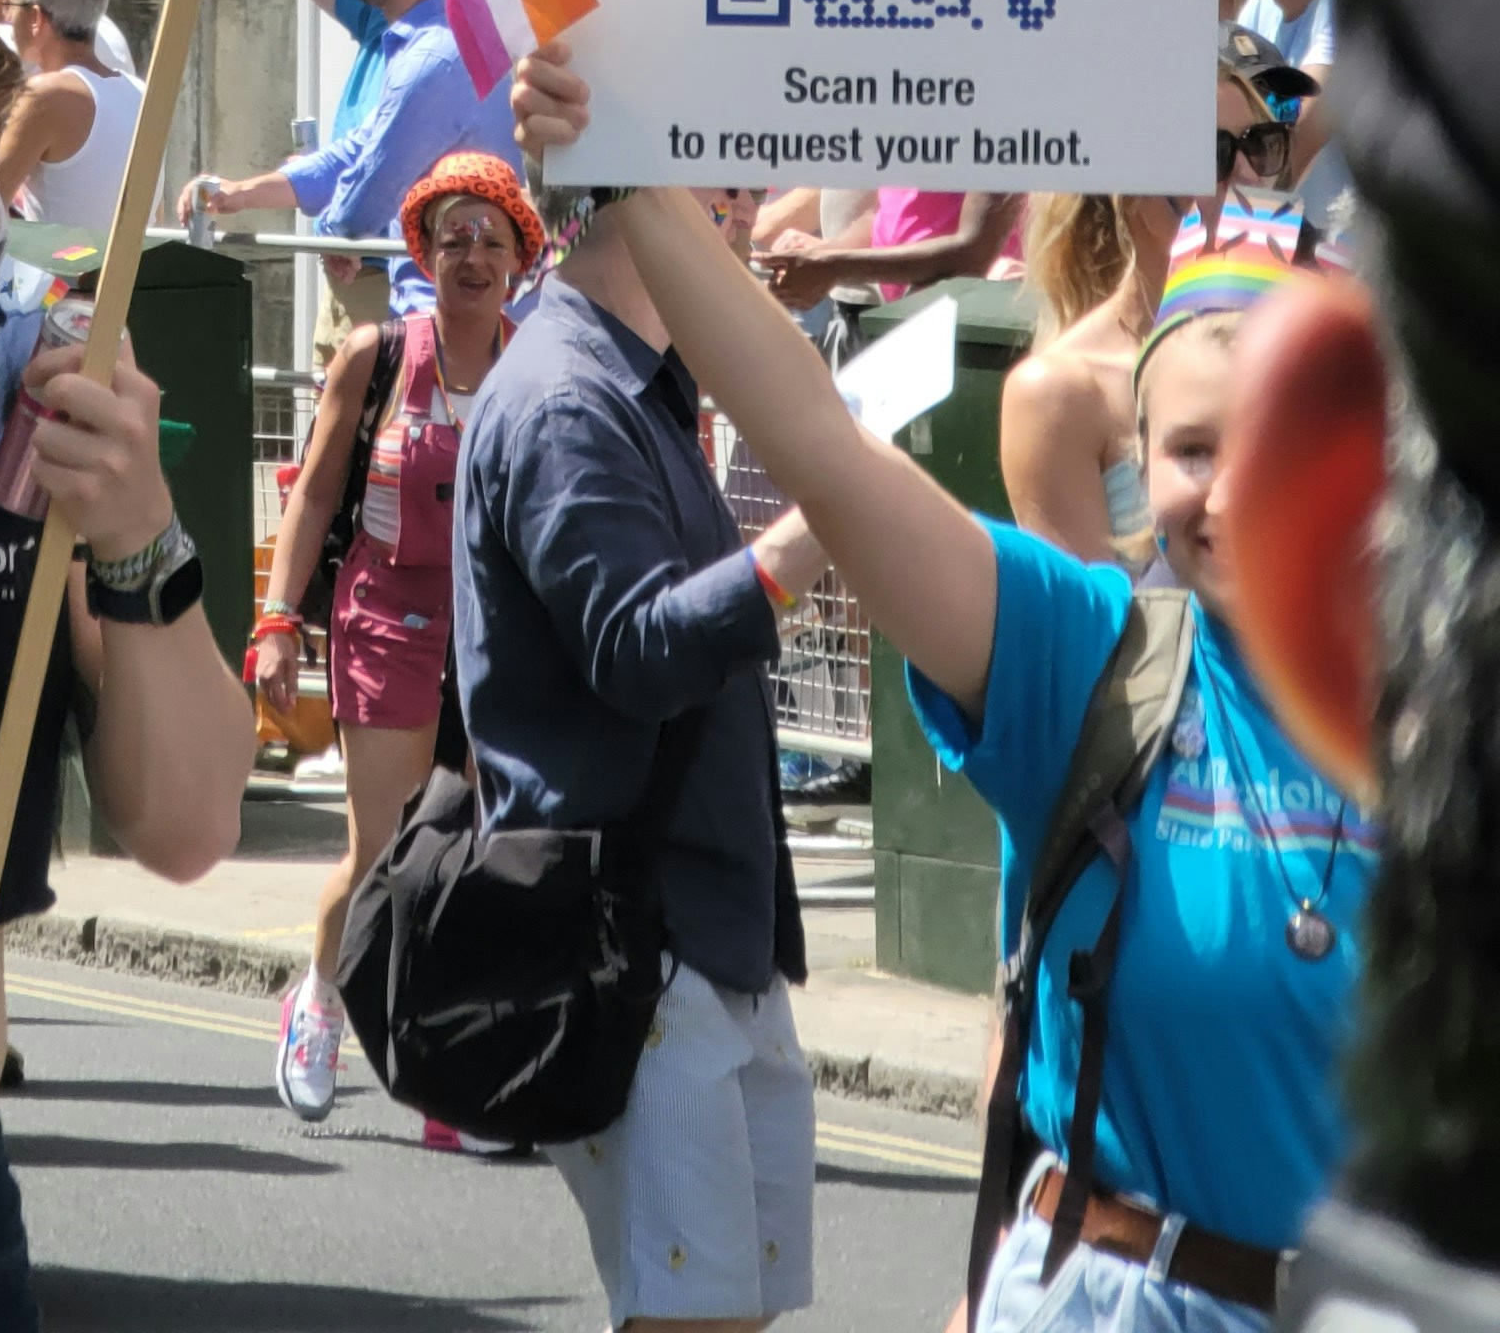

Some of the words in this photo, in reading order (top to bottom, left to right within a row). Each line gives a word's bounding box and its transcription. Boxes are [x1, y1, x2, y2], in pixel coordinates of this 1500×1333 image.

[784, 67, 877, 105] Scan
[892, 69, 976, 106] here
[668, 124, 705, 160] to
[718, 127, 863, 169] request
[875, 132, 960, 171] your
[973, 128, 1091, 166] ballot.
